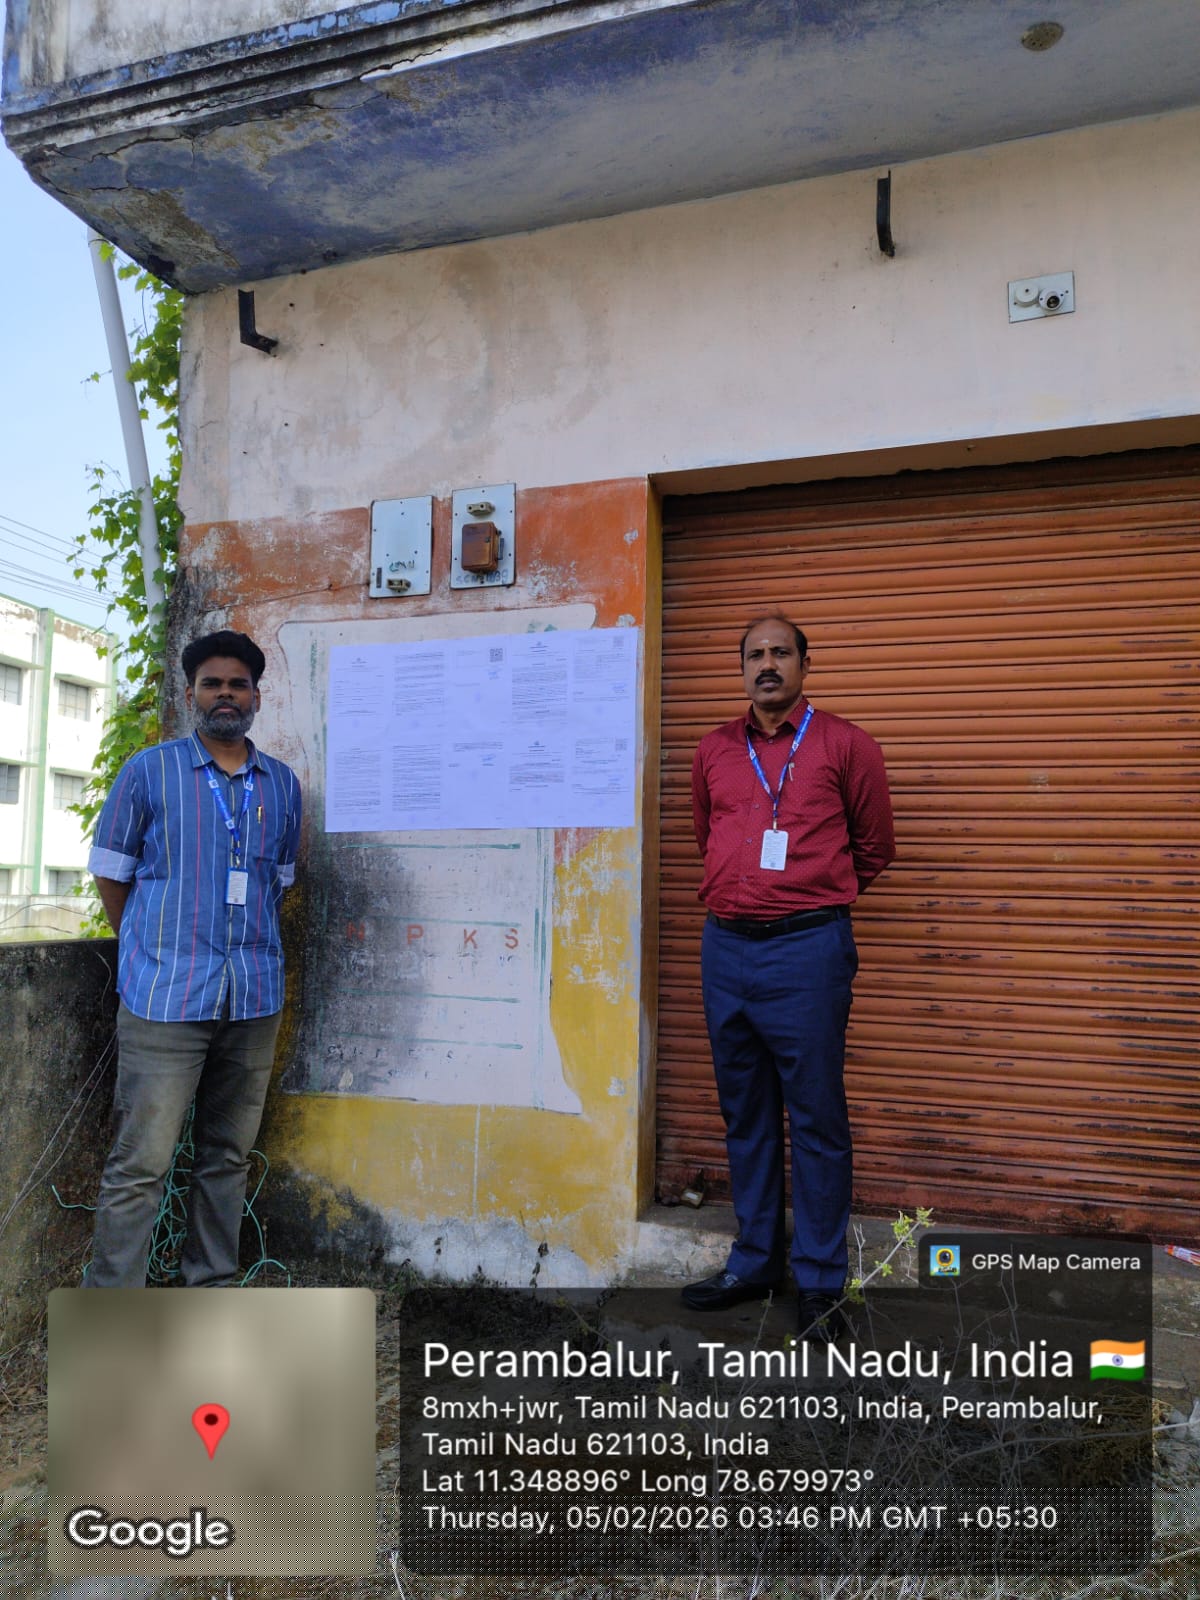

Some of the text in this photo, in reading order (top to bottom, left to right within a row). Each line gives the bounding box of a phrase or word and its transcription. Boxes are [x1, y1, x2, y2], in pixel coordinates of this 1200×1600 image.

[407, 925, 424, 946] P
[463, 928, 478, 948] K
[504, 928, 519, 948] S
